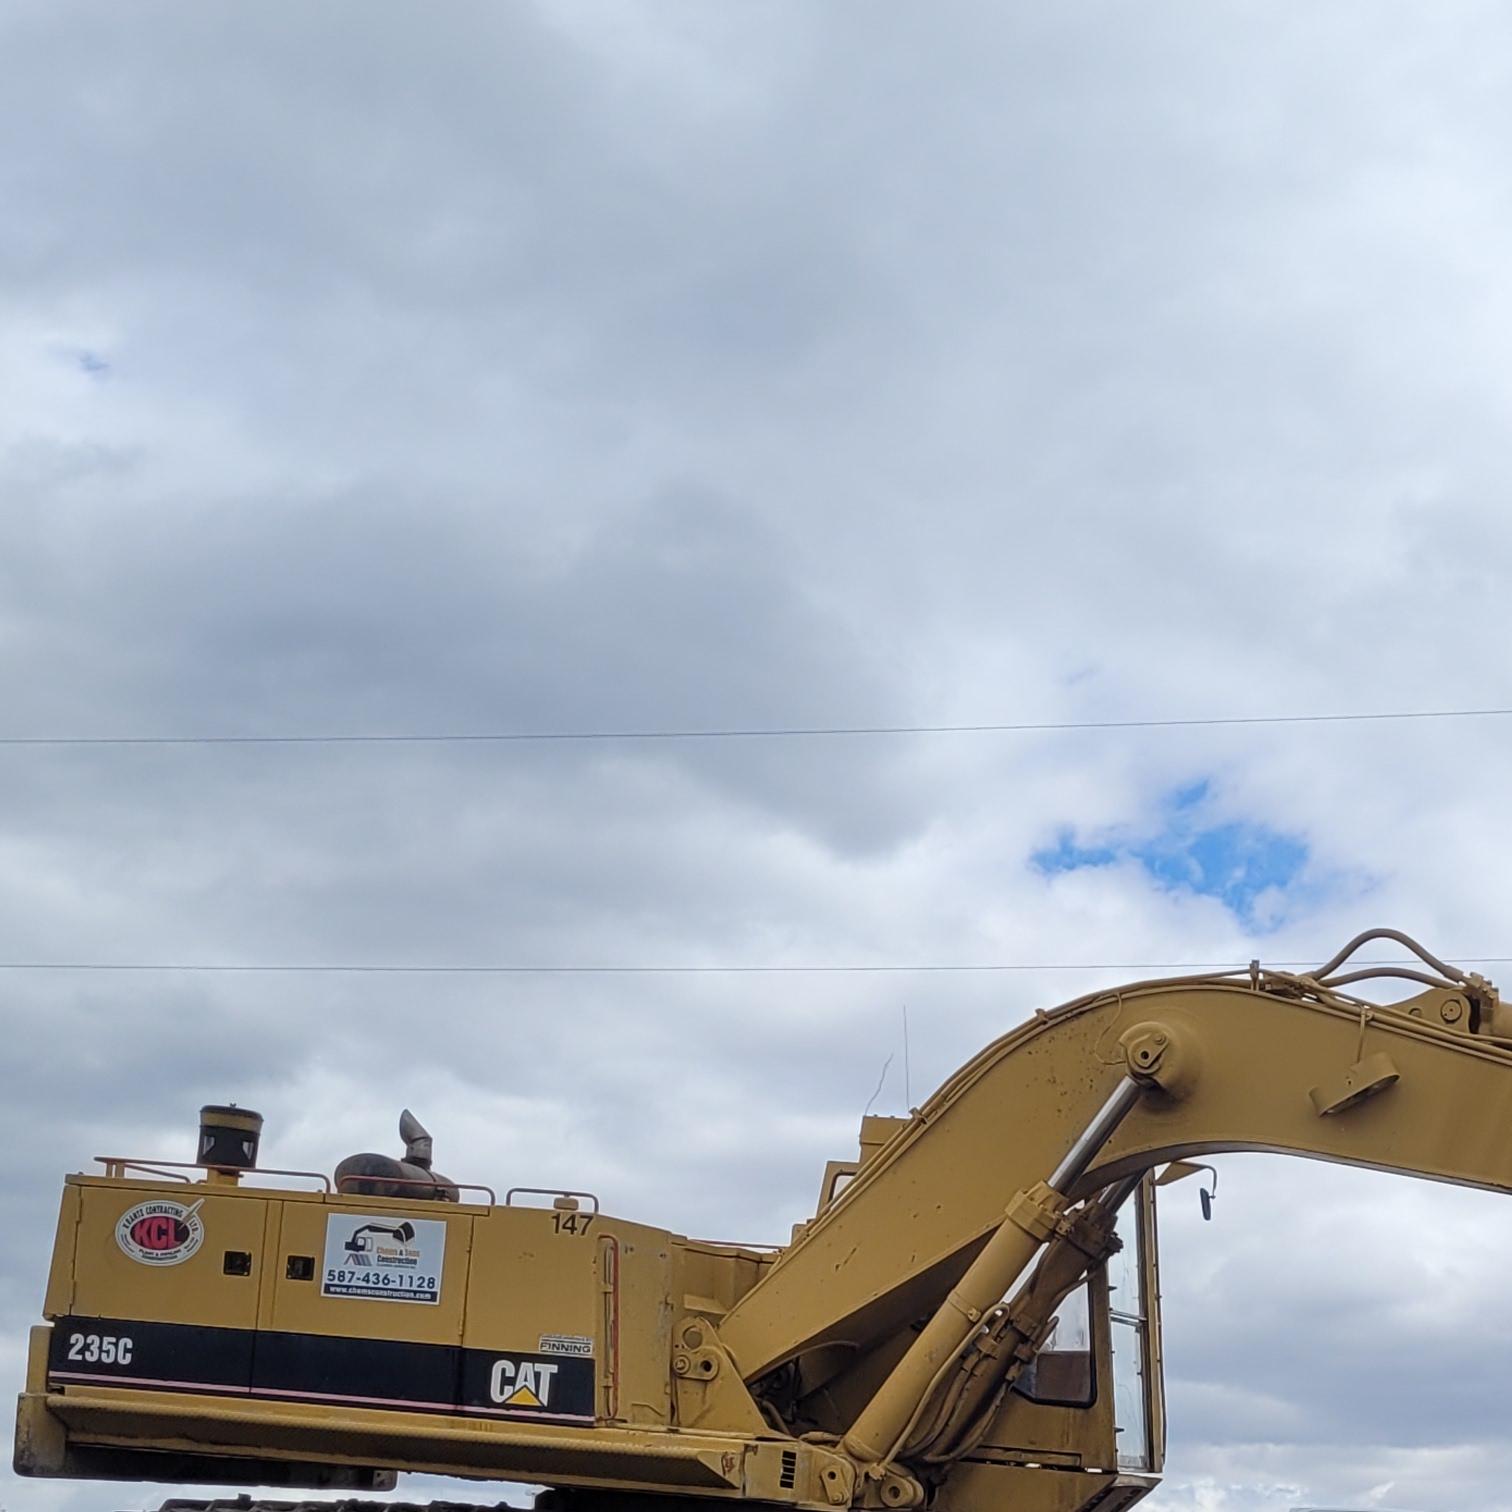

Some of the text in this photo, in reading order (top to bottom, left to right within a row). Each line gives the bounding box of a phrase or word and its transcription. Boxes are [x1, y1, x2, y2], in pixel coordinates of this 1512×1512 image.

[134, 1217, 182, 1249] KCL
[551, 1213, 594, 1236] 147
[376, 1254, 418, 1265] Construction
[327, 1269, 436, 1289] 587-436-1128
[68, 1333, 133, 1365] 235C
[540, 1341, 592, 1353] FINNING
[490, 1359, 558, 1408] CAT
